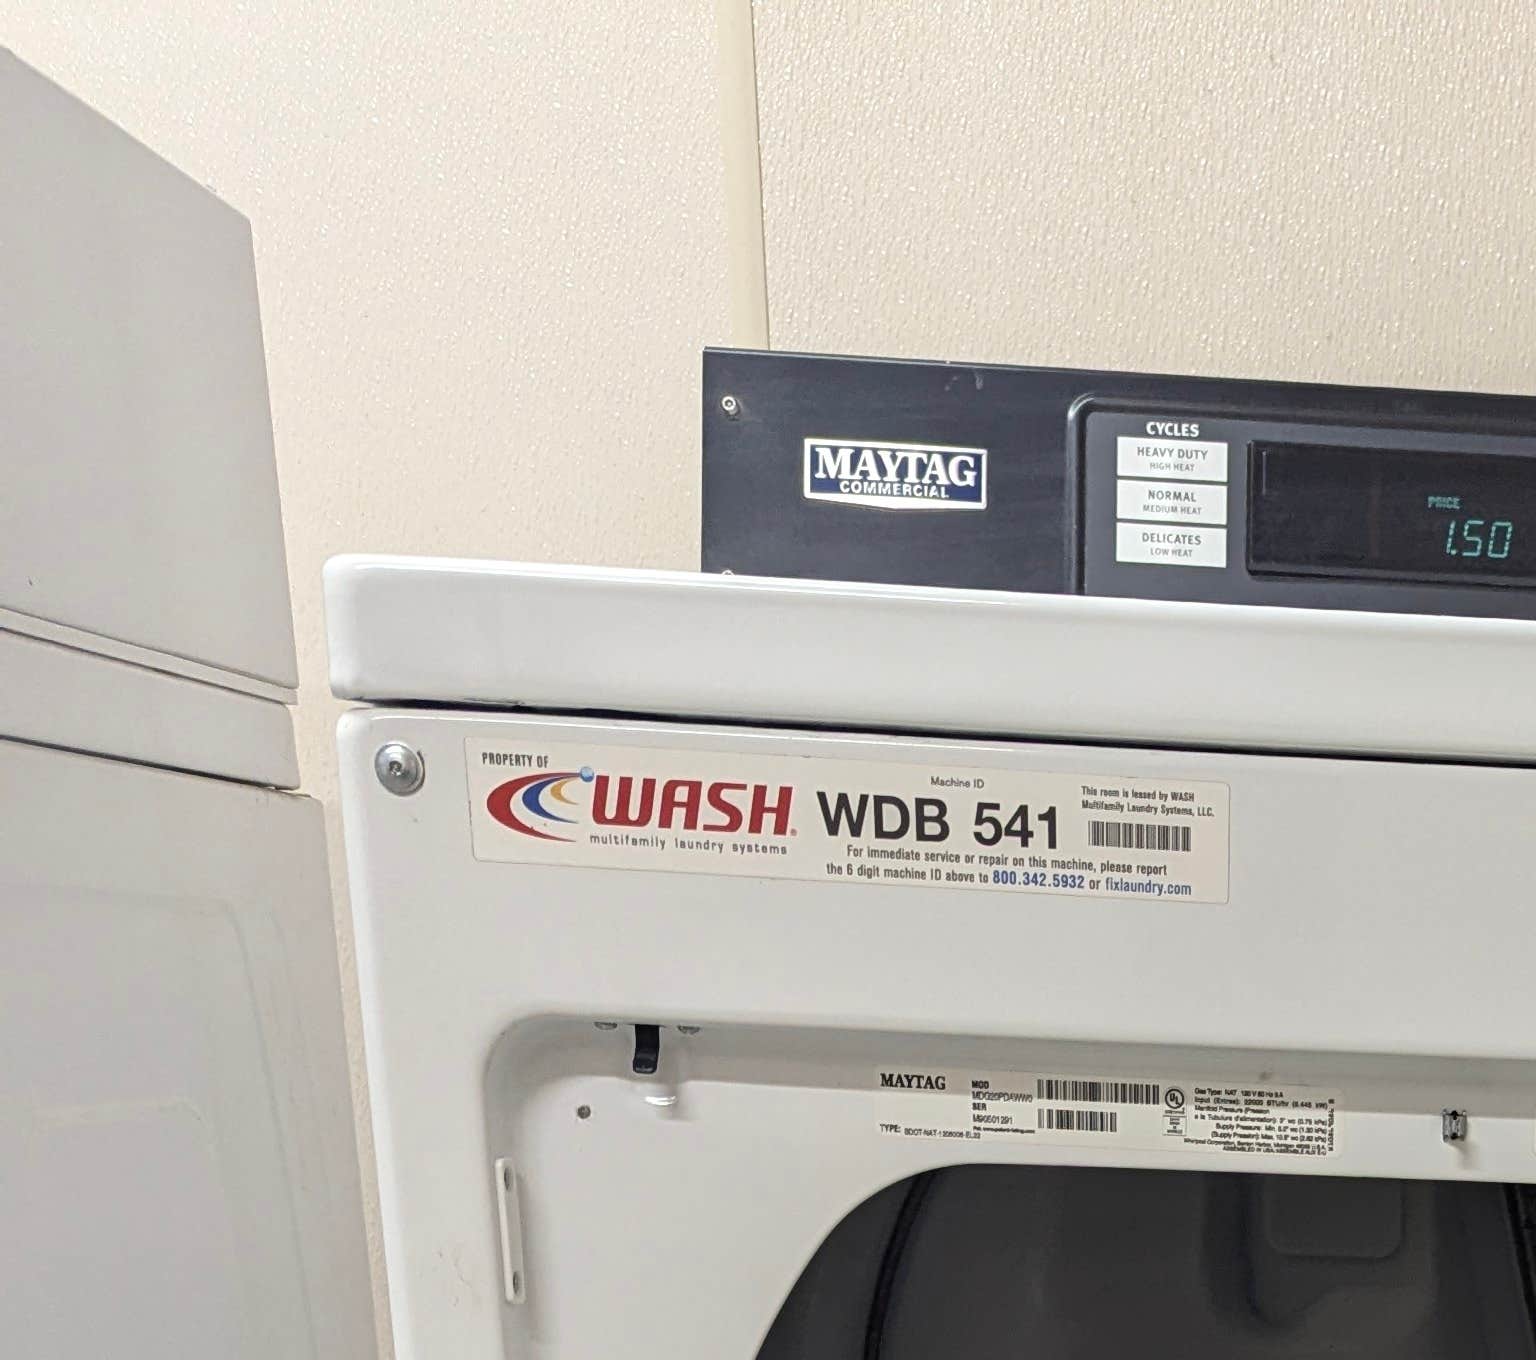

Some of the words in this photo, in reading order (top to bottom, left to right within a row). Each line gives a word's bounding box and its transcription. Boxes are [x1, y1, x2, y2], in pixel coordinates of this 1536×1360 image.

[1146, 421, 1199, 438] CYCLES
[1136, 446, 1173, 460] HEAVY
[1176, 448, 1209, 462] DUTY
[814, 447, 978, 488] MAYTAG
[1149, 461, 1171, 471] HIGH
[1173, 462, 1195, 473] HEAT
[839, 480, 949, 499] COMMERCIAL
[1147, 489, 1197, 503] NORMAL
[1142, 504, 1175, 514] MEDIUM
[1178, 505, 1202, 516] HEAT
[1141, 531, 1202, 547] DELICATES
[1446, 520, 1513, 560] 1.50
[1150, 547, 1169, 557] LOW
[1171, 548, 1193, 558] HEAT
[482, 752, 534, 768] PROPERTY
[536, 754, 549, 769] OF
[931, 776, 971, 789] Machine
[973, 778, 985, 789] ID
[1081, 786, 1098, 796] This
[1100, 788, 1120, 797] room
[1122, 788, 1129, 798] is
[1131, 789, 1157, 800] leased
[1158, 790, 1168, 802] by
[1170, 791, 1195, 802] WASH
[591, 775, 793, 836] WASH
[1081, 800, 1124, 813] Multifamily
[1127, 803, 1158, 816] Laundry
[1161, 804, 1194, 817] Systems,
[1197, 806, 1215, 817] LLC.
[816, 791, 951, 842] WDB
[973, 802, 1057, 850] 541
[590, 833, 666, 851] multifamily
[674, 837, 724, 854] laundry
[732, 842, 788, 855] systems
[846, 845, 865, 858] For
[867, 847, 922, 862] immediate
[924, 851, 960, 863] service
[964, 855, 976, 865] or
[978, 853, 1009, 868] repair
[1012, 857, 1024, 867] on
[1028, 855, 1047, 869] this
[1050, 857, 1097, 873] machine,
[1100, 860, 1133, 876] please
[1136, 862, 1168, 877] report
[826, 862, 843, 876] the
[846, 864, 854, 876] 6
[857, 863, 880, 880] digit
[883, 865, 926, 880] machine
[930, 868, 942, 881] ID
[945, 869, 975, 882] above
[978, 871, 989, 883] to
[992, 869, 1085, 890] 800.342.5932
[1089, 879, 1101, 890] or
[1105, 876, 1192, 896] fixlaundry.com
[880, 1073, 946, 1091] MAYTAG
